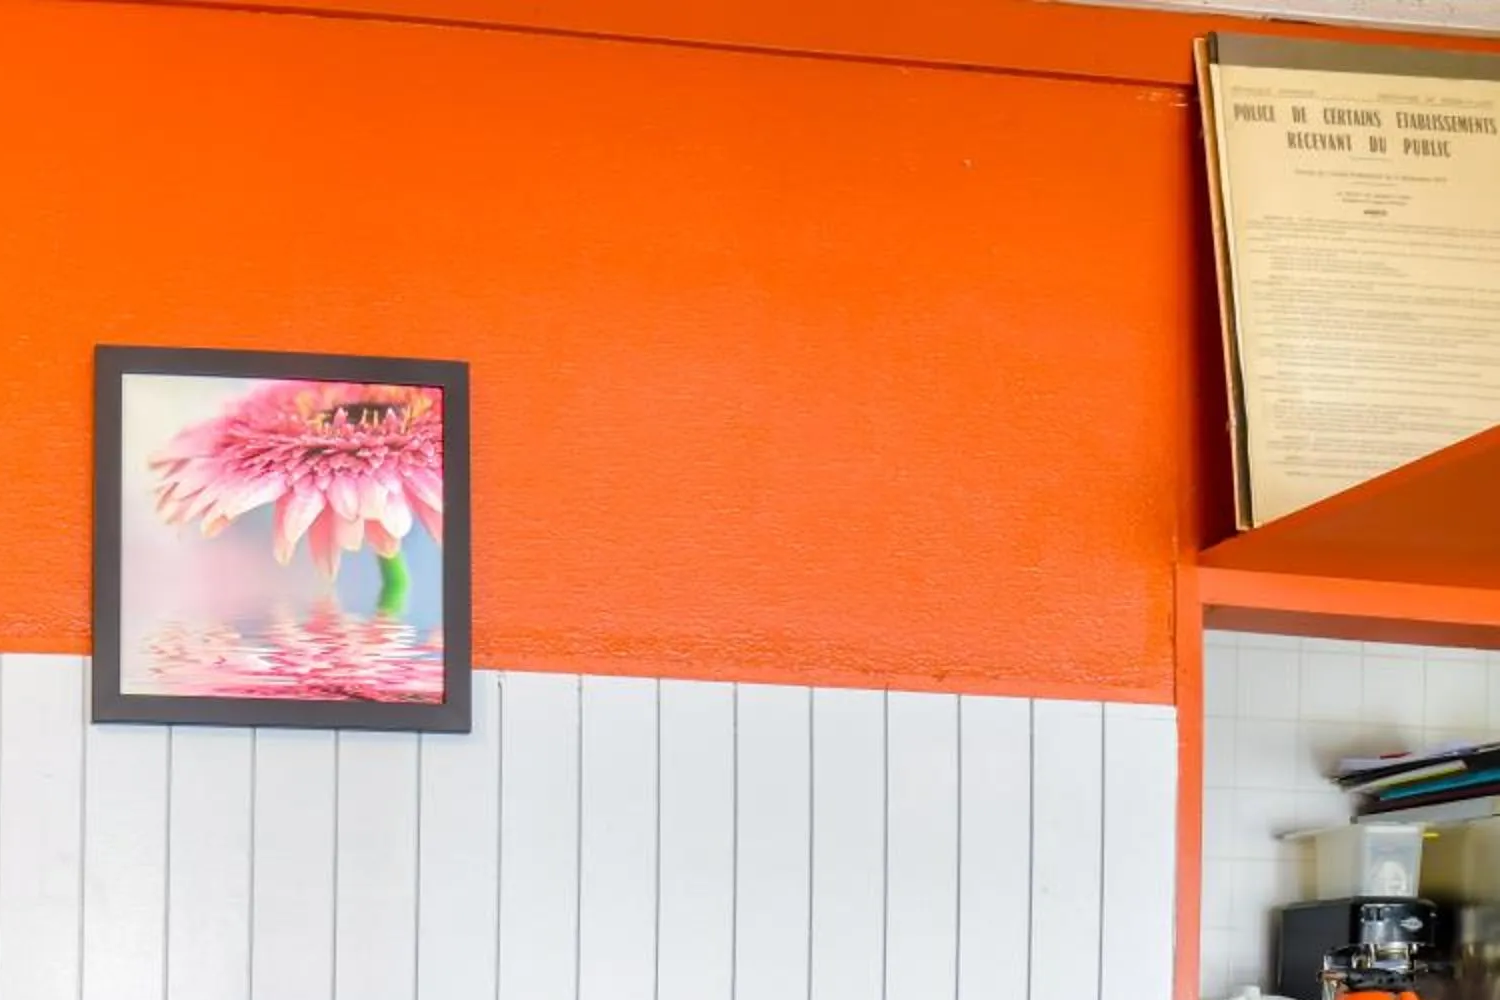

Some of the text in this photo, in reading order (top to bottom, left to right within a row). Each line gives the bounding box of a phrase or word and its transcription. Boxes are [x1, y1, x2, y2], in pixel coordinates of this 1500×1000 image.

[1233, 102, 1498, 136] POLICE DE CERTAINS ETABLISSEMENTS
[1286, 131, 1452, 158] RECEVANT DU PUBLIC
